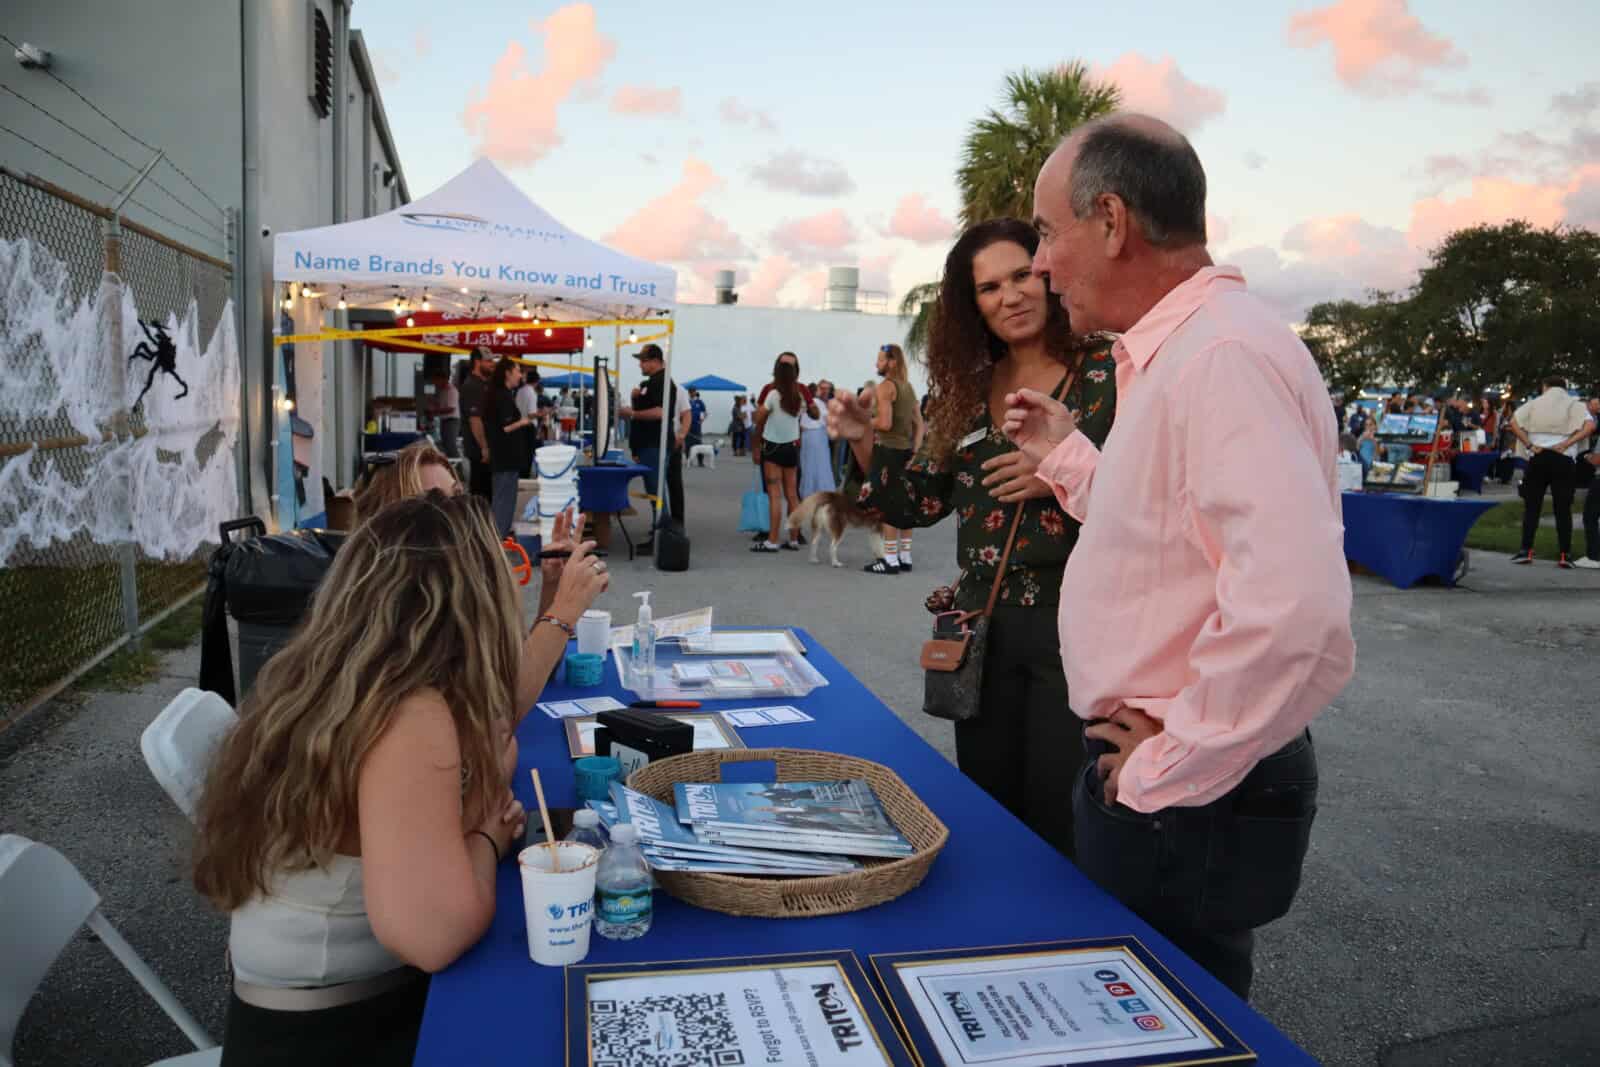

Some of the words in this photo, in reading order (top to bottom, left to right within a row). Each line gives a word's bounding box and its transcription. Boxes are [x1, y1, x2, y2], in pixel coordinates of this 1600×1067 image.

[294, 250, 360, 272] Name
[368, 254, 444, 277] Brands
[452, 260, 491, 280] You
[498, 265, 558, 286] Know
[564, 273, 602, 290] and
[609, 274, 658, 298] Trust
[743, 987, 766, 1018] RSVP?
[755, 1017, 770, 1029] to
[810, 982, 864, 1053] TRITON
[942, 991, 987, 1042] TRITON
[759, 1029, 784, 1064] Forgot
